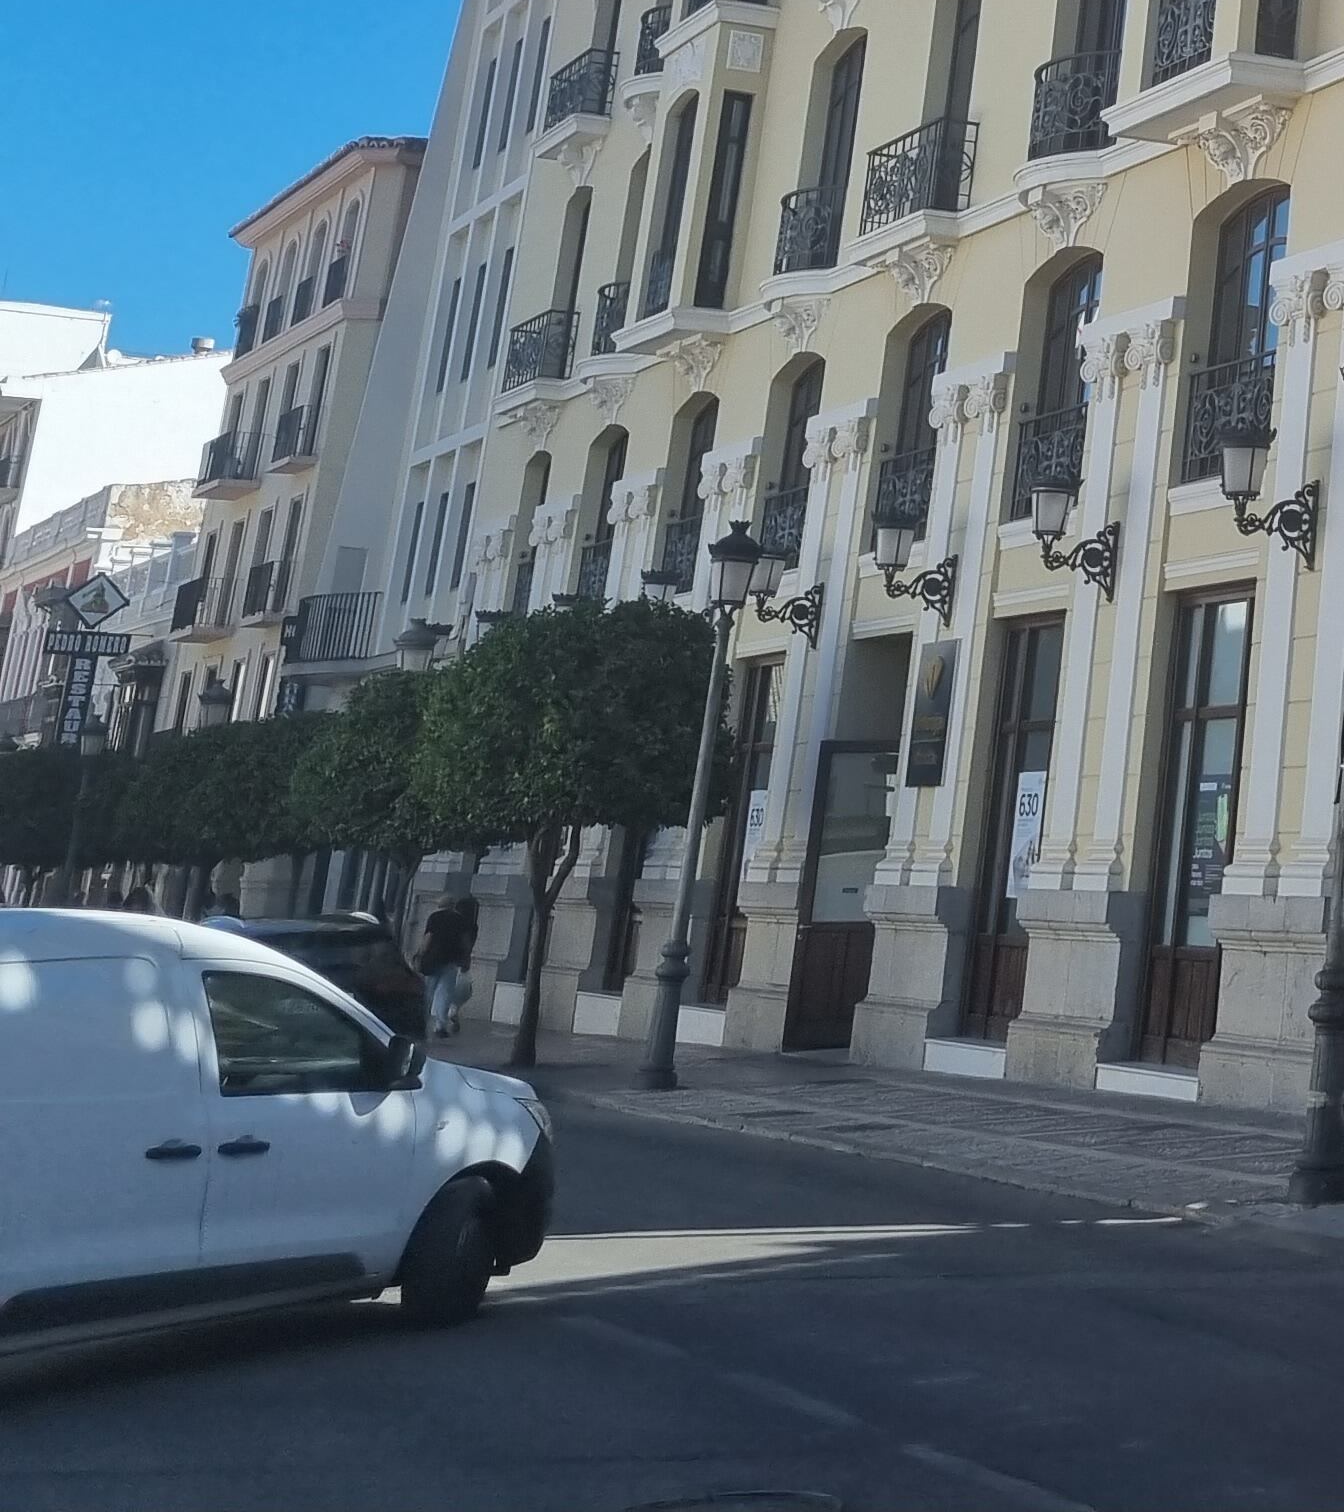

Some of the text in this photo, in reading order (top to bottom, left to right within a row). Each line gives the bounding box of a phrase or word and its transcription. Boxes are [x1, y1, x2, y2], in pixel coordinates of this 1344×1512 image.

[47, 633, 128, 654] PEDRO ROMERO
[1019, 792, 1039, 817] 630
[750, 807, 764, 828] 630
